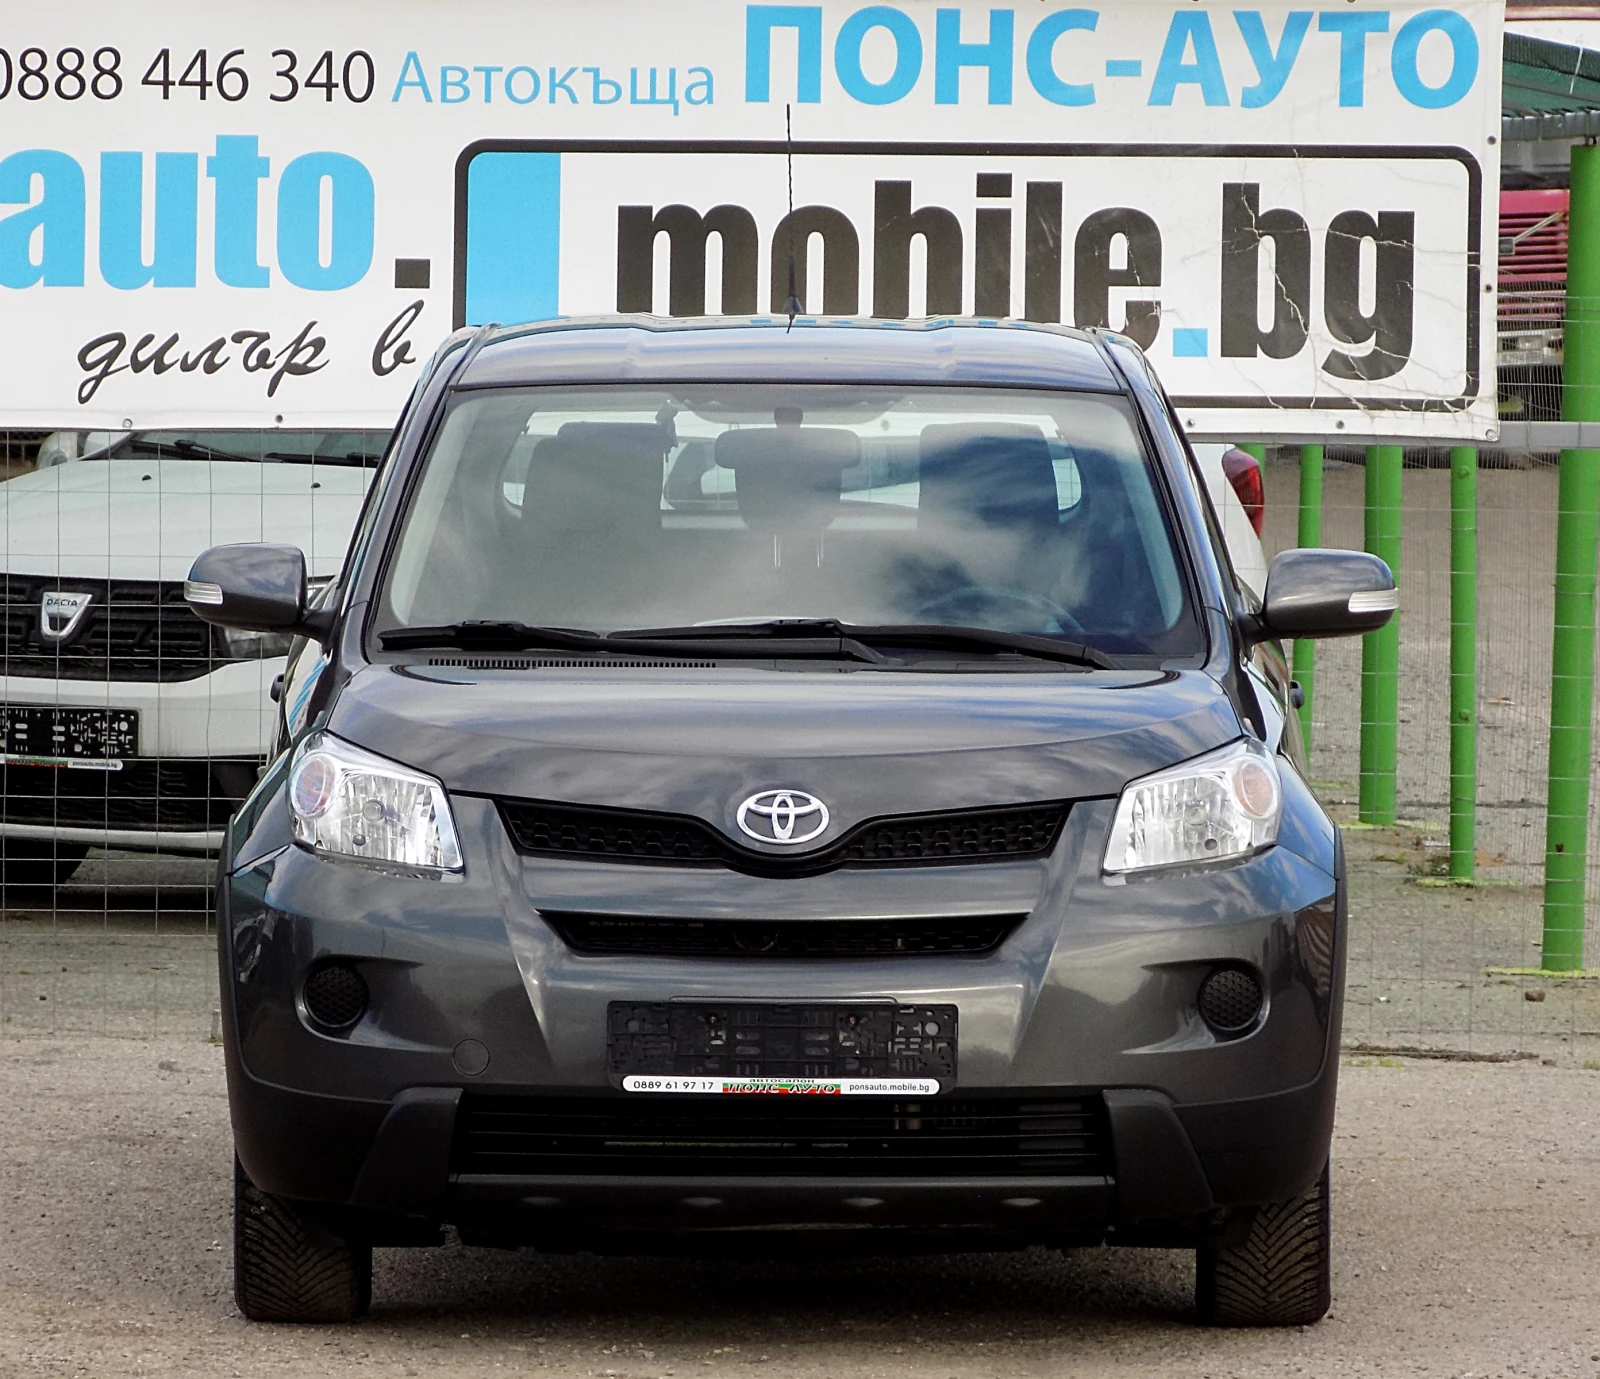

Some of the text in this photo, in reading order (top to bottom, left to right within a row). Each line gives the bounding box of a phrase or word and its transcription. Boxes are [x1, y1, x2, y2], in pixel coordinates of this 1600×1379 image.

[141, 48, 249, 102] 446
[269, 49, 375, 104] 340
[392, 51, 714, 116] Автокъща
[744, 4, 1480, 110] ПОНС-АУТО
[616, 172, 1415, 381] mobile.bg
[77, 321, 330, 405] дилър
[633, 1080, 714, 1091] 0889 61 97 17
[849, 1084, 930, 1093] ponsauto.mobile.bg
